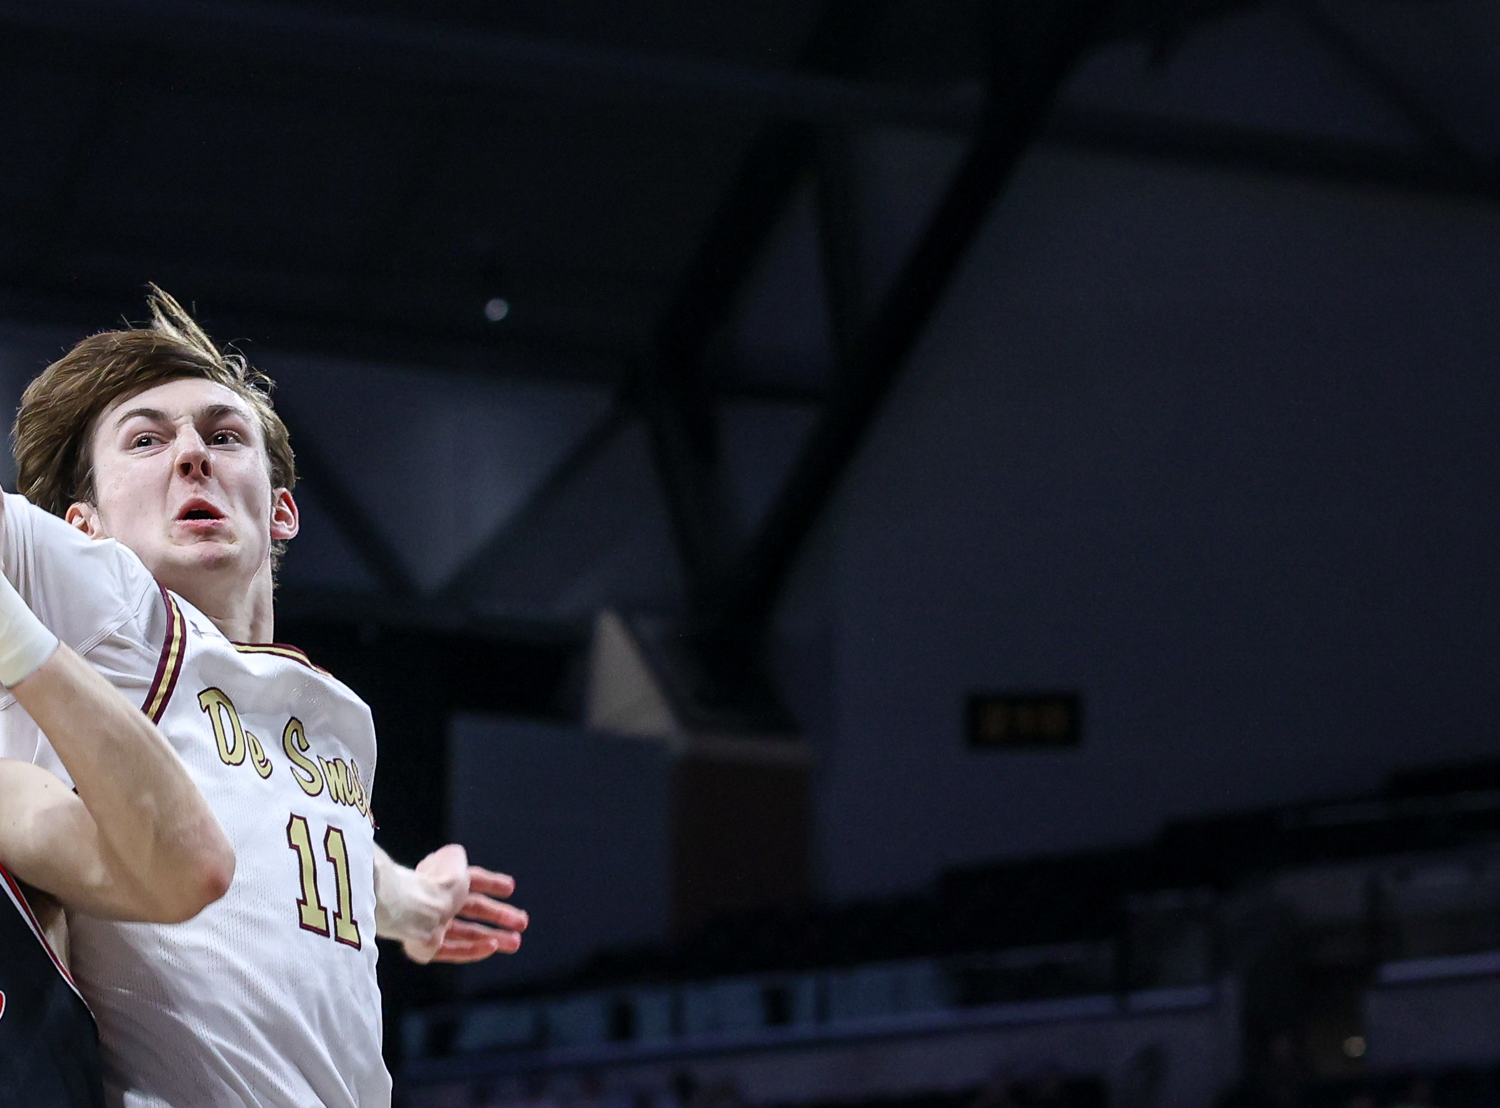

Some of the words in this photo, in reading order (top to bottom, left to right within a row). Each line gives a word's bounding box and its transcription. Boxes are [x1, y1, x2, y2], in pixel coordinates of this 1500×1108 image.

[197, 686, 273, 779] De
[282, 715, 377, 828] Sme
[285, 812, 362, 950] 11
